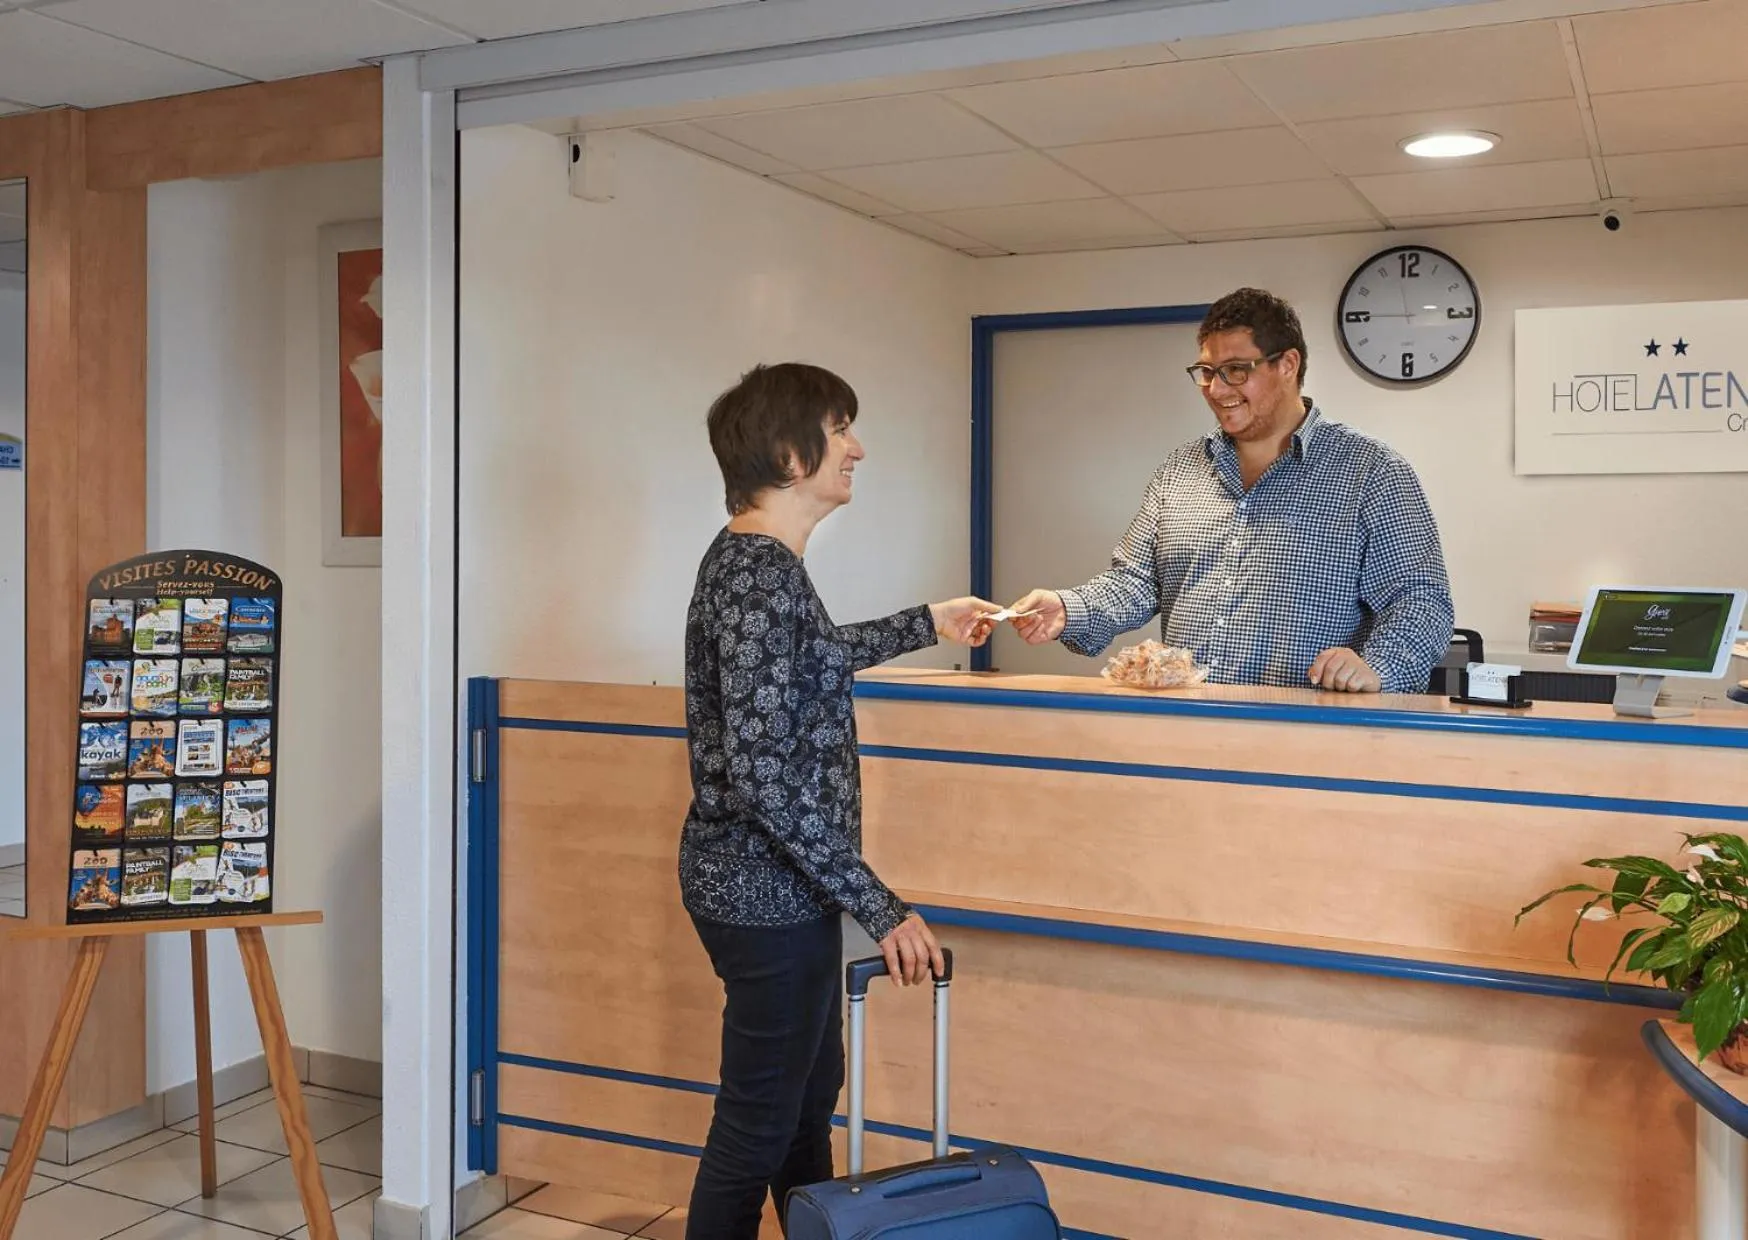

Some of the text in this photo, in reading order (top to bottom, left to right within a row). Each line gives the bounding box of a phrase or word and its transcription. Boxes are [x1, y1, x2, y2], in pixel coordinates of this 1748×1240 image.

[1398, 252, 1420, 278] 12
[1431, 264, 1439, 276] 1
[1447, 282, 1460, 293] 2
[1345, 310, 1371, 323] 9
[1446, 307, 1473, 319] 3
[1447, 334, 1460, 343] 4
[1378, 353, 1387, 364] 7
[1428, 352, 1439, 363] 5
[1401, 352, 1414, 378] 6
[99, 559, 273, 591] VISITES PASSION
[155, 580, 215, 589] Servez-vous
[80, 748, 121, 761] kayak
